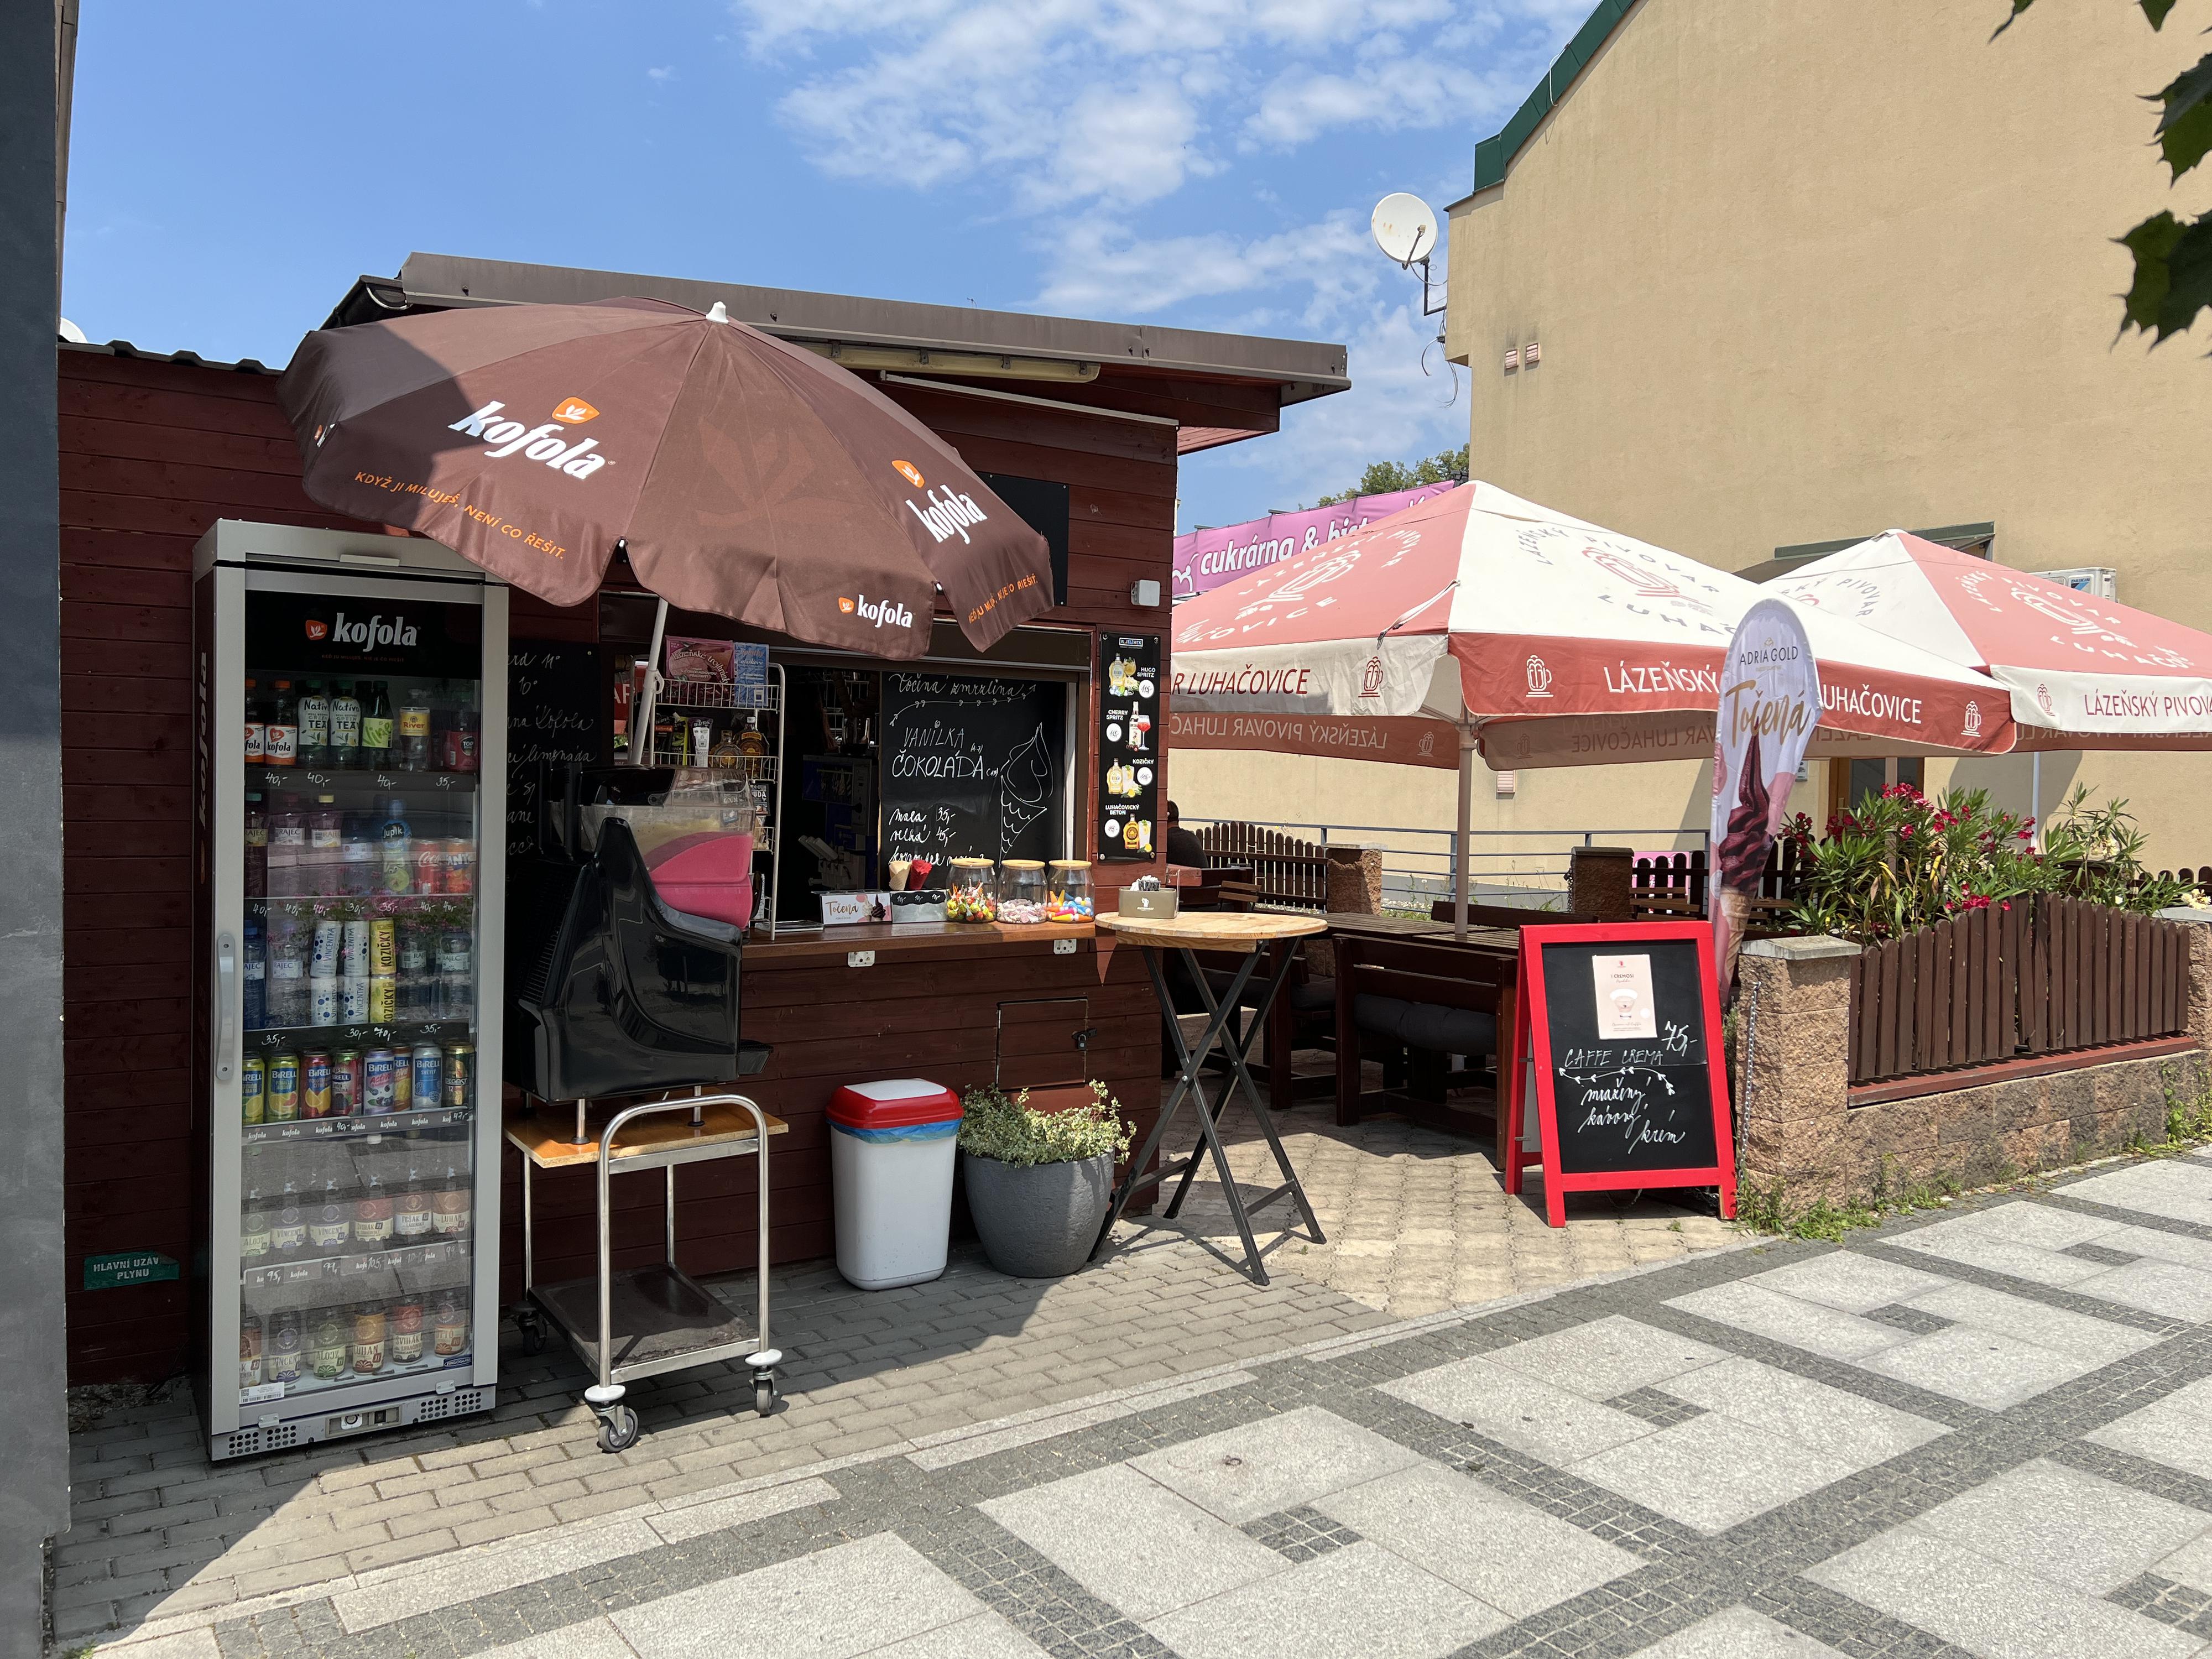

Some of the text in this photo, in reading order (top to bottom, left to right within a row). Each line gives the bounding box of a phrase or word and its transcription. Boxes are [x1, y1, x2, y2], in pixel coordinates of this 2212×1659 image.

[447, 400, 605, 479] kofola
[354, 472, 566, 559] KDYŽ JI MILUJEŠ, NENÍ CO ŘEŠIT.
[905, 484, 988, 544] kofola
[1200, 526, 1319, 576] cukrárna &
[857, 594, 913, 628] kofola
[332, 612, 419, 652] kofola
[672, 650, 707, 660] Lázeňské
[1740, 646, 1798, 666] ADRIA GOLD
[1187, 665, 1311, 695] LUHAČOVICE
[1604, 660, 1720, 694] LÁZEŇSKÝ
[1823, 684, 1922, 724] UHAČOVICE
[2085, 688, 2212, 717] LÁZEŇSKÝ PIVOV
[1725, 680, 1812, 748] Točená
[309, 720, 327, 728] TEA
[336, 721, 356, 729] TEA
[403, 721, 425, 729] River
[199, 651, 208, 828] kofola
[245, 738, 260, 752] fola
[267, 740, 291, 755] kofola
[892, 749, 983, 780] ČOKOLÁDA
[446, 853, 471, 865] ANT
[825, 901, 859, 916] Točená
[323, 927, 336, 961] VINCENTKA
[356, 982, 364, 1016] VINCENTKA
[1564, 1048, 1663, 1067] CAFFE CREMA
[316, 1125, 332, 1134] kofola
[380, 1120, 397, 1129] kofola
[412, 1118, 428, 1126] kofola
[282, 1129, 300, 1138] kofola
[93, 1256, 159, 1272] HLAVNÍ UZÁV
[388, 1257, 401, 1265] kofol
[425, 1252, 435, 1260] fola
[117, 1269, 149, 1280] PLYNU
[290, 1270, 307, 1279] kofola
